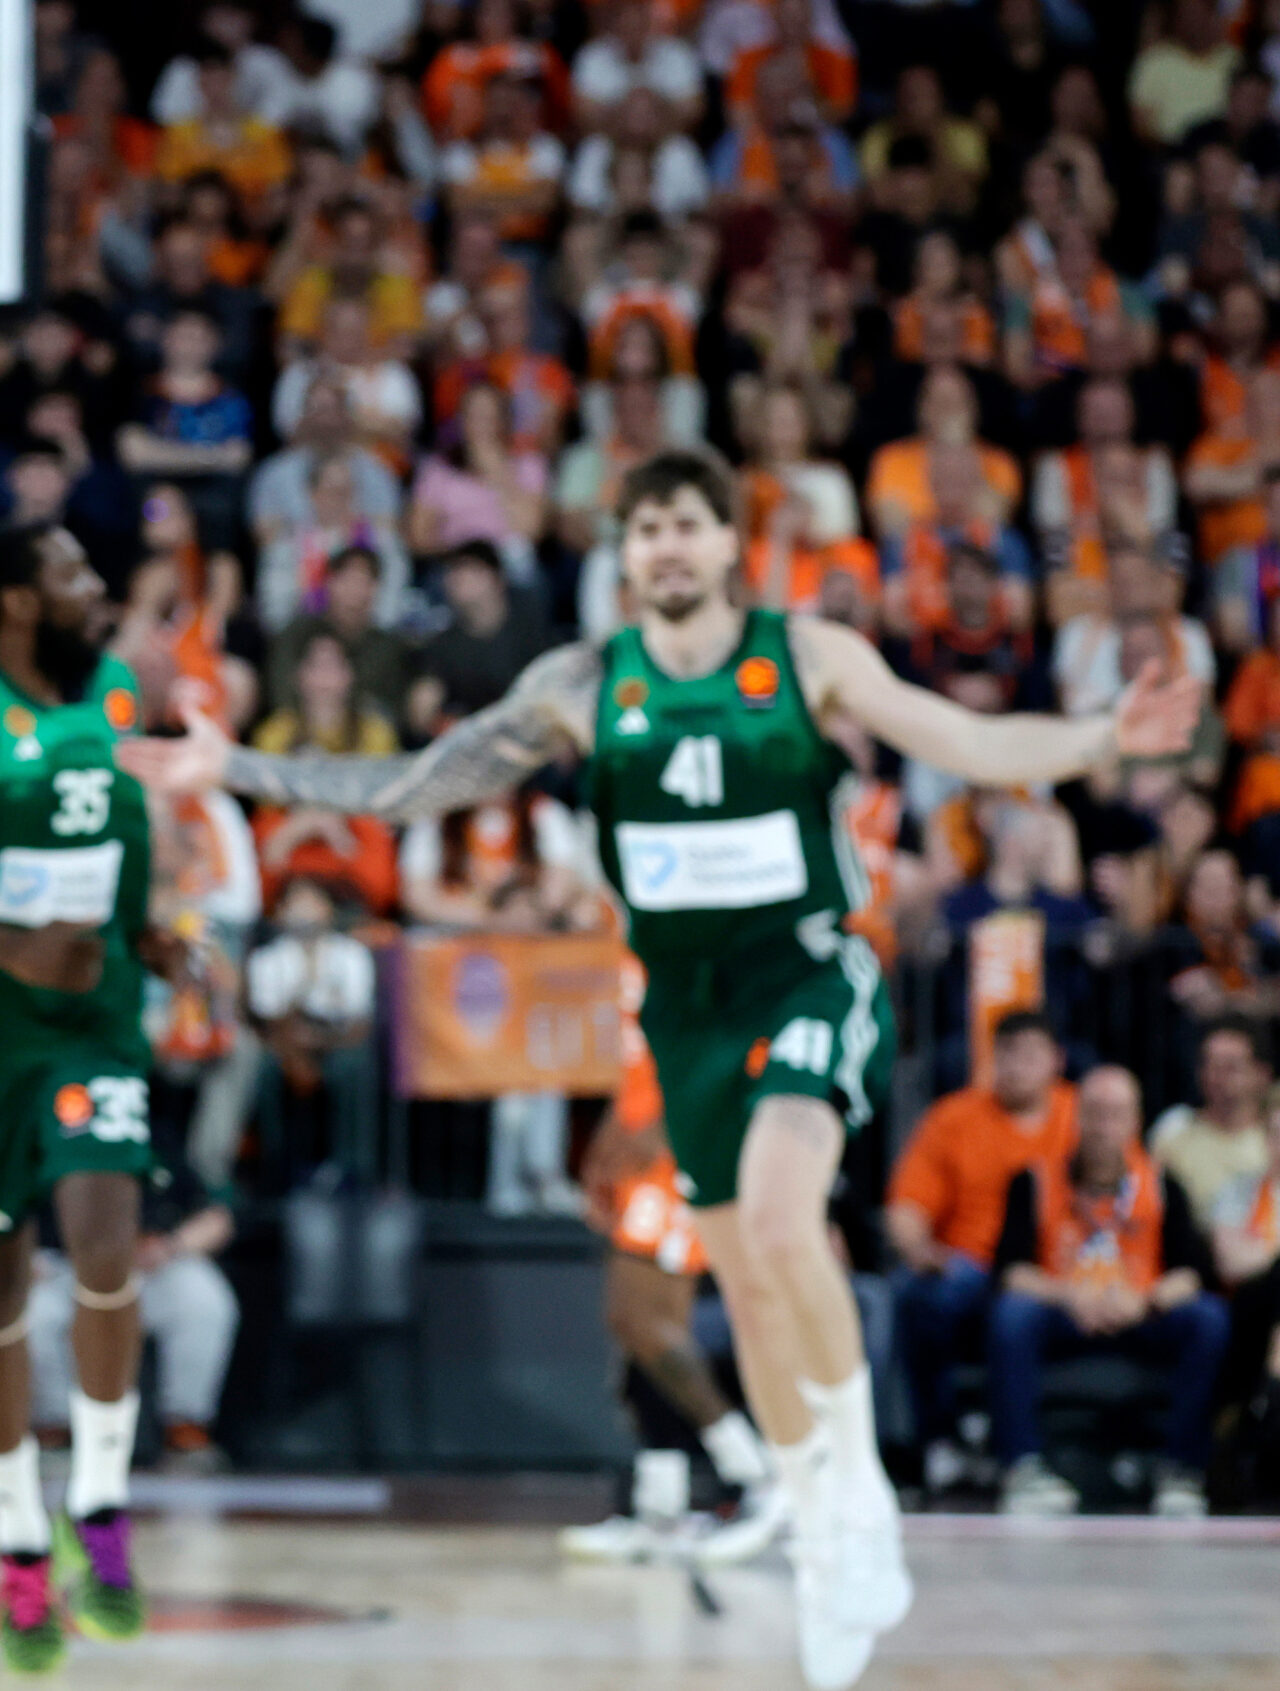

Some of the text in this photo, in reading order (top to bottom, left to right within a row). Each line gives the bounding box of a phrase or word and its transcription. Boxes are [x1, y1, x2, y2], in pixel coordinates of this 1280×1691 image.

[50, 768, 115, 837] 35
[659, 734, 725, 809] 41
[770, 1016, 834, 1077] 41
